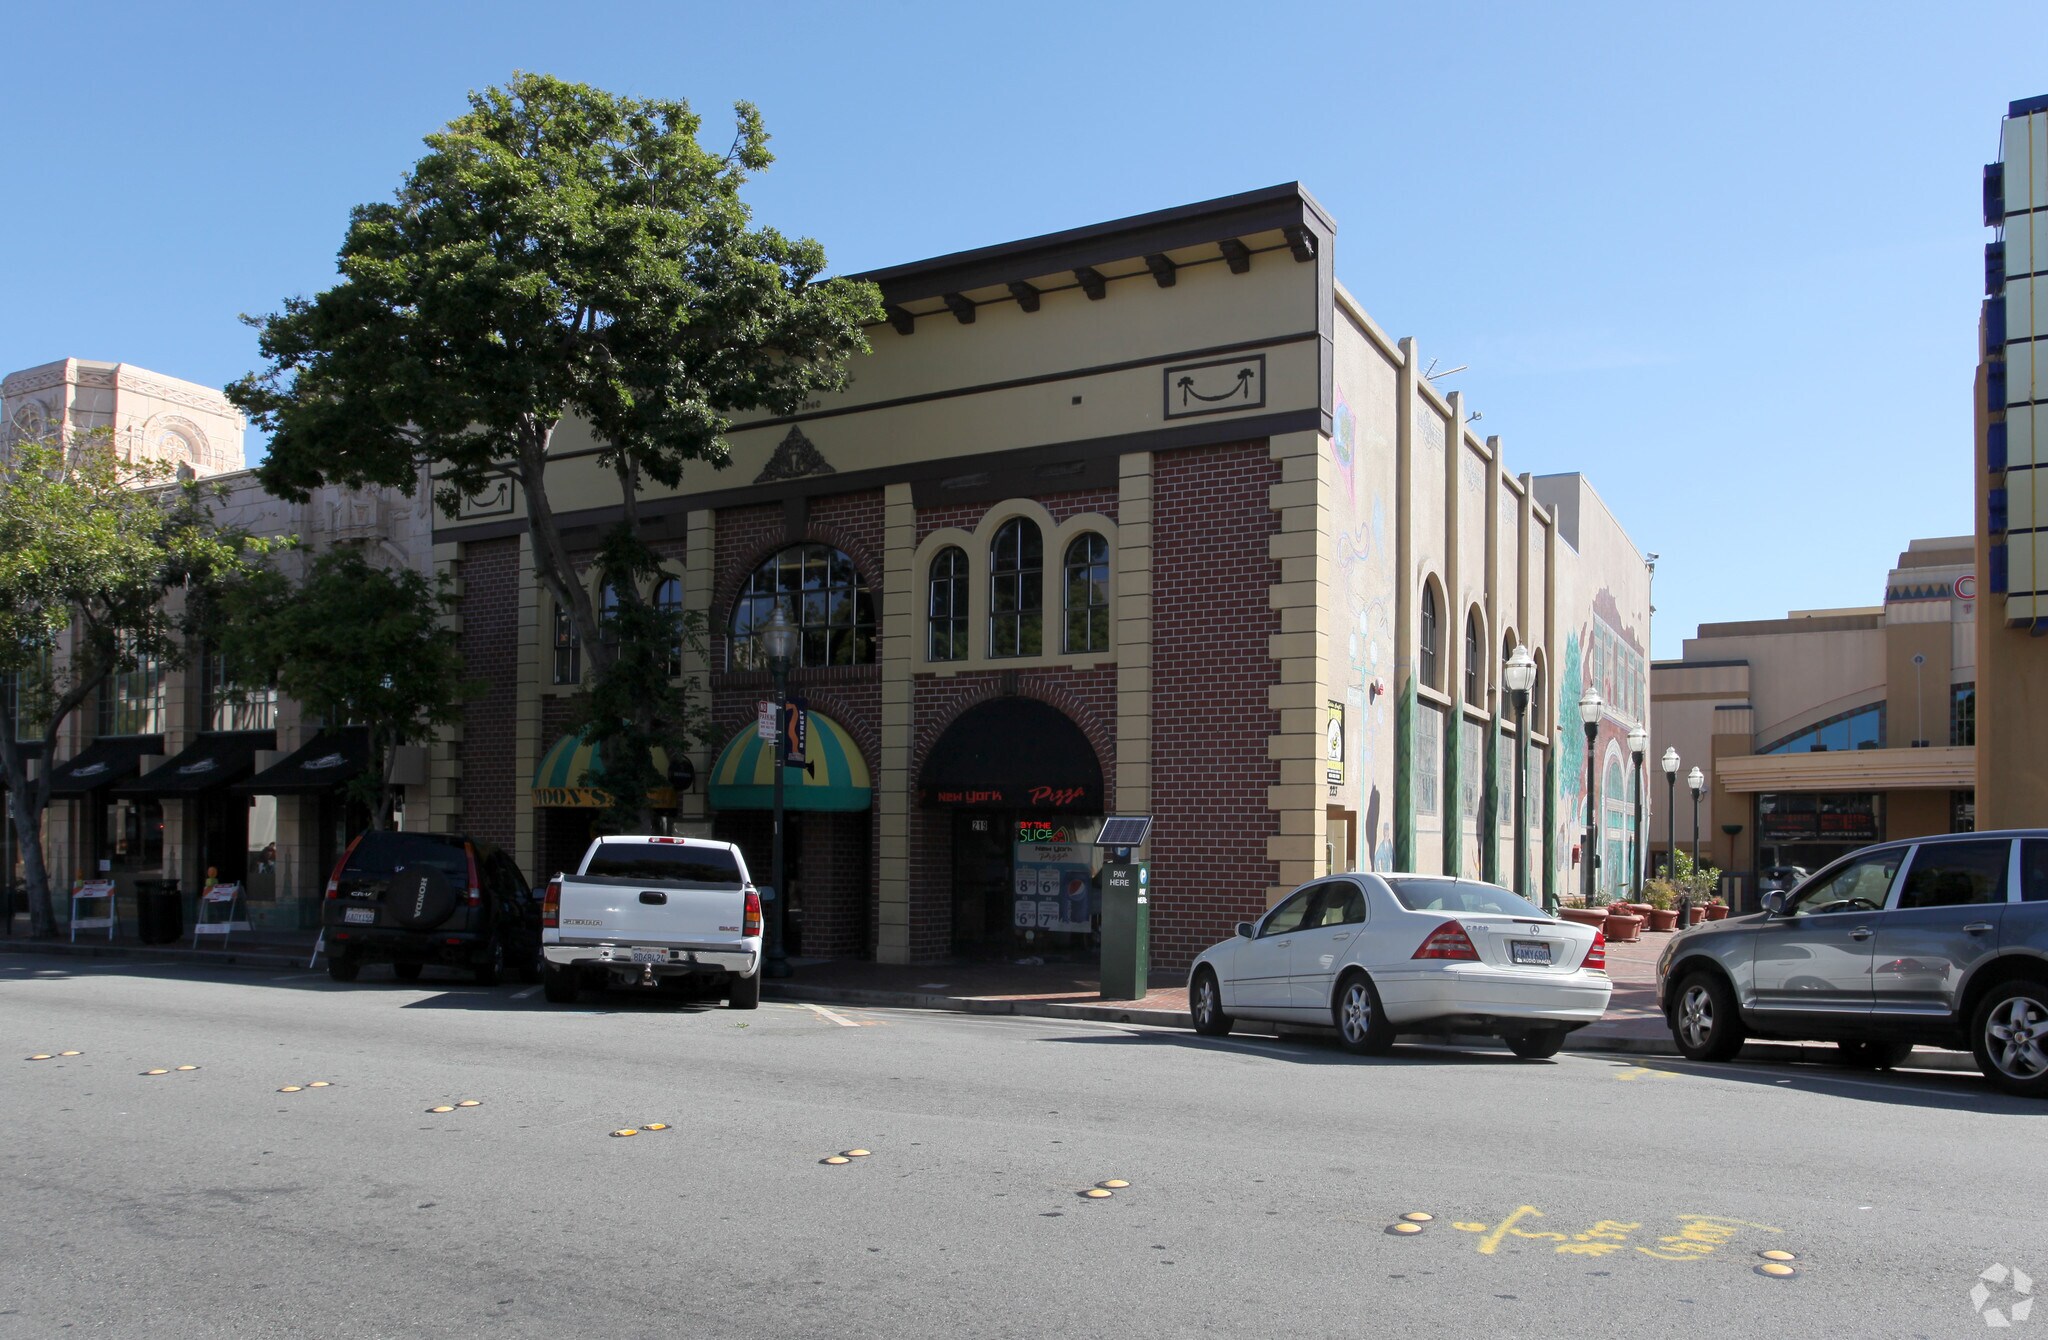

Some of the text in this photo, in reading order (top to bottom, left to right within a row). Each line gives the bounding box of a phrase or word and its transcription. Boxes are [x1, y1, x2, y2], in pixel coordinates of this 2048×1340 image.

[759, 713, 775, 721] PARKING
[937, 791, 962, 802] New
[965, 790, 1003, 805] York
[1028, 785, 1085, 807] Pizza
[1329, 785, 1338, 797] 223
[973, 820, 987, 830] 219
[1019, 821, 1052, 829] BY THE
[1019, 828, 1053, 843] SLICE
[1113, 870, 1126, 878] PAY
[413, 876, 428, 919] HONDA
[633, 952, 665, 963] 8D68424
